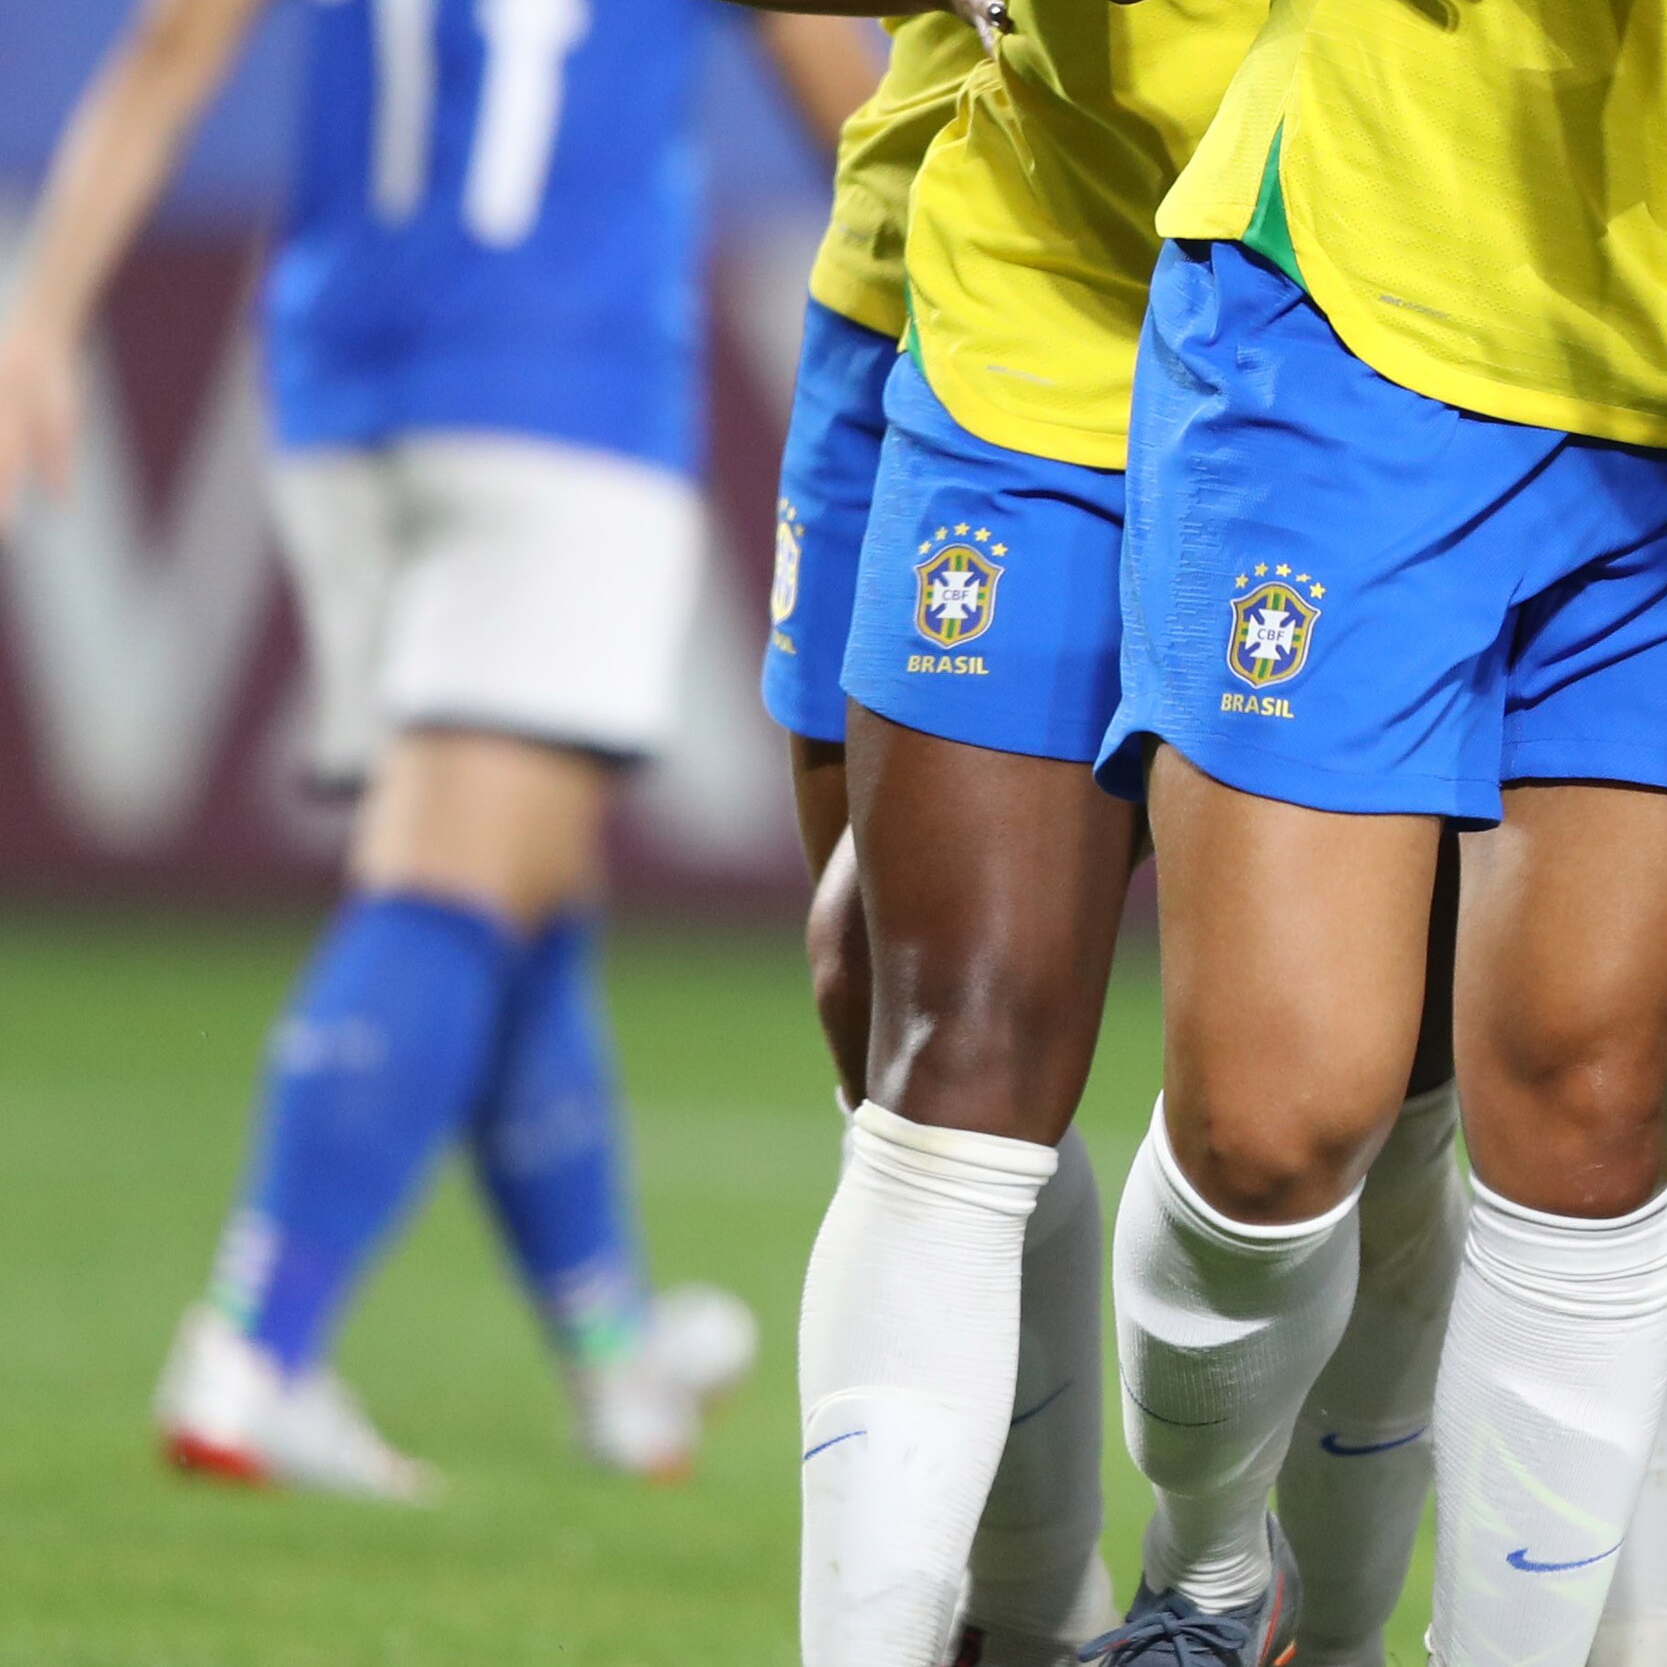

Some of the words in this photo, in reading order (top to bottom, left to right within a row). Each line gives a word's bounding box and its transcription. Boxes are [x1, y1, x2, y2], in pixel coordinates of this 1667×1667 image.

[941, 589, 970, 601] CBF
[1257, 628, 1285, 642] CBF
[906, 655, 990, 675] BRASIL
[1220, 692, 1295, 719] BRASIL
